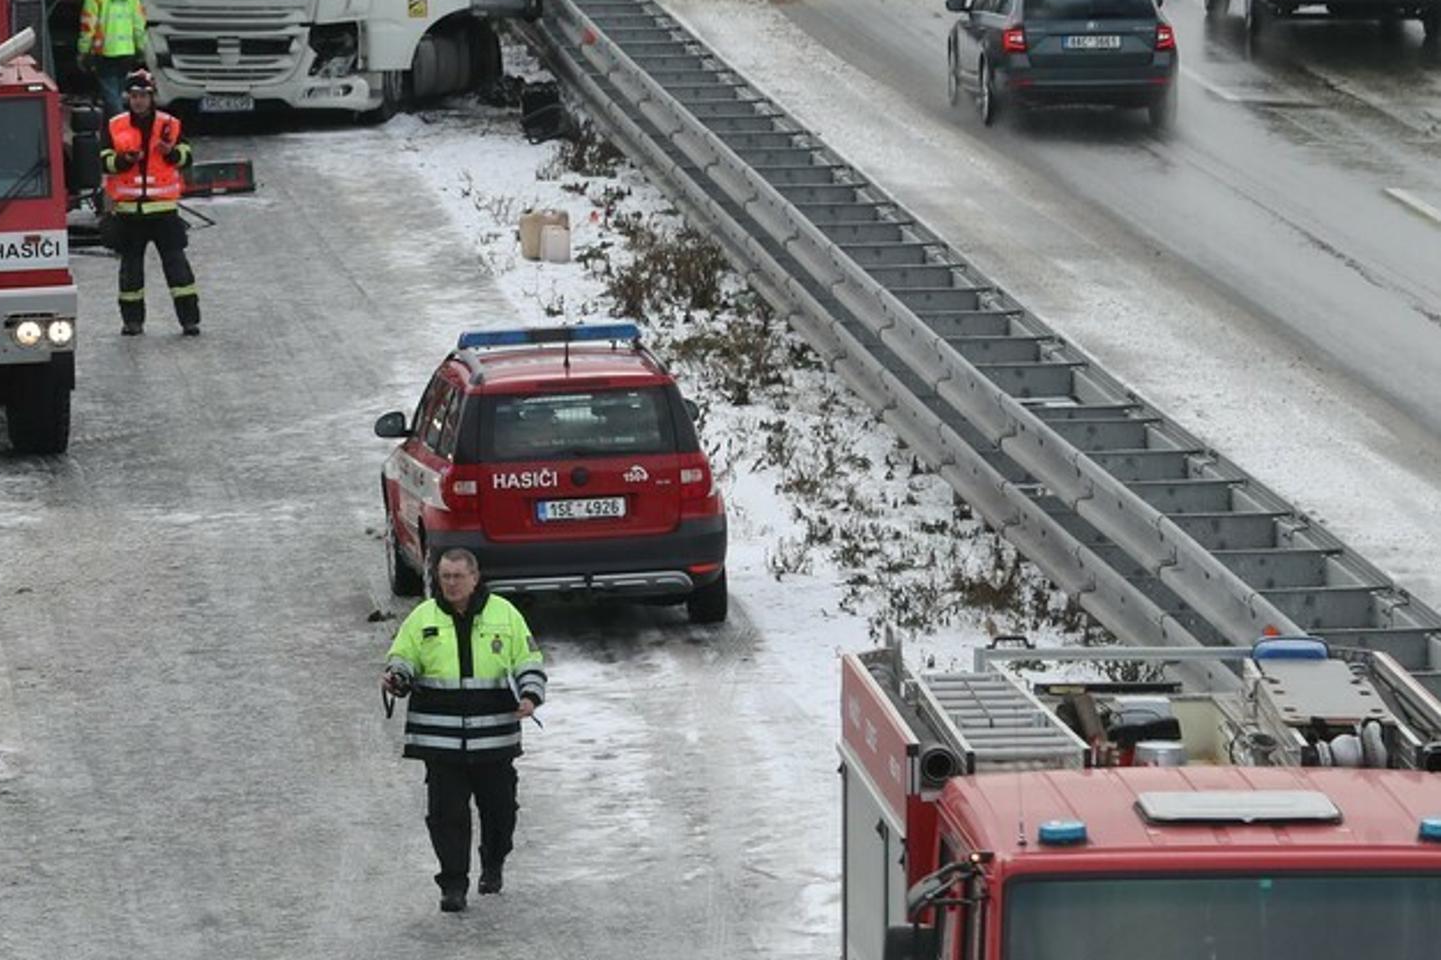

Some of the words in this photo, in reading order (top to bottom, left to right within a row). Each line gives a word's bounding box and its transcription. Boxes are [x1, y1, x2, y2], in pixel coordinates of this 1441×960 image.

[492, 467, 558, 489] HASIČI
[551, 502, 574, 517] 1SE
[585, 500, 620, 516] 4926
